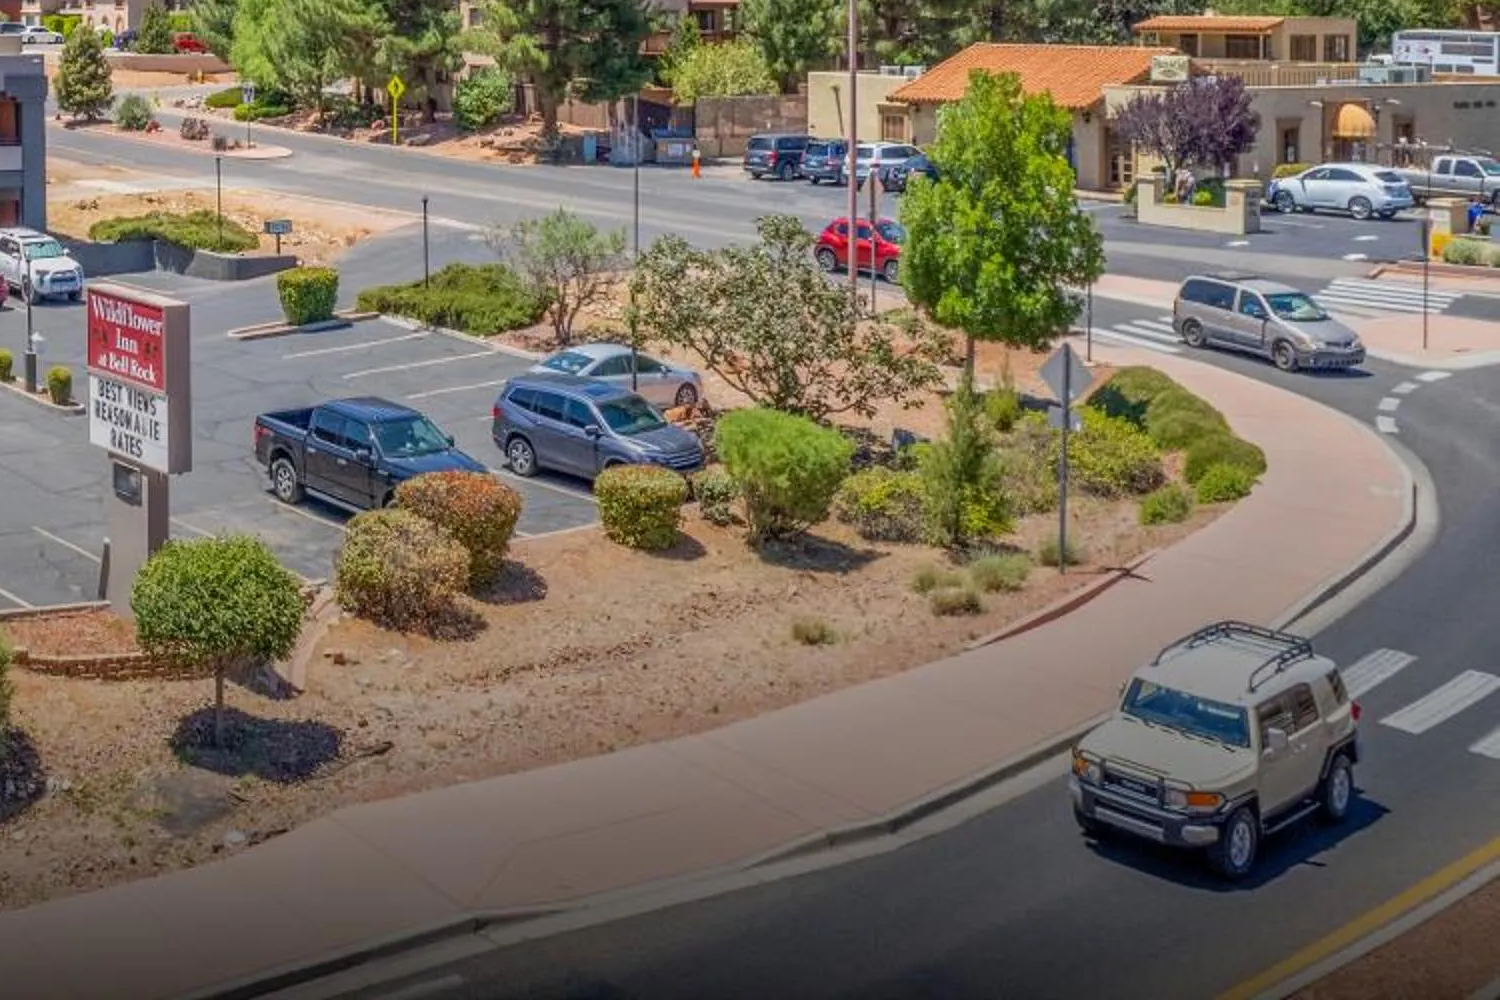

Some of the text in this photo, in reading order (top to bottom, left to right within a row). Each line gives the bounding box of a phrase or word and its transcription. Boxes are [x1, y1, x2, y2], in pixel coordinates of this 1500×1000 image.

[91, 295, 162, 337] Wildflower
[116, 327, 138, 355] Inn
[98, 351, 156, 384] at Bell Rock
[99, 379, 157, 416] BEST VIEWS
[110, 427, 143, 459] RATES
